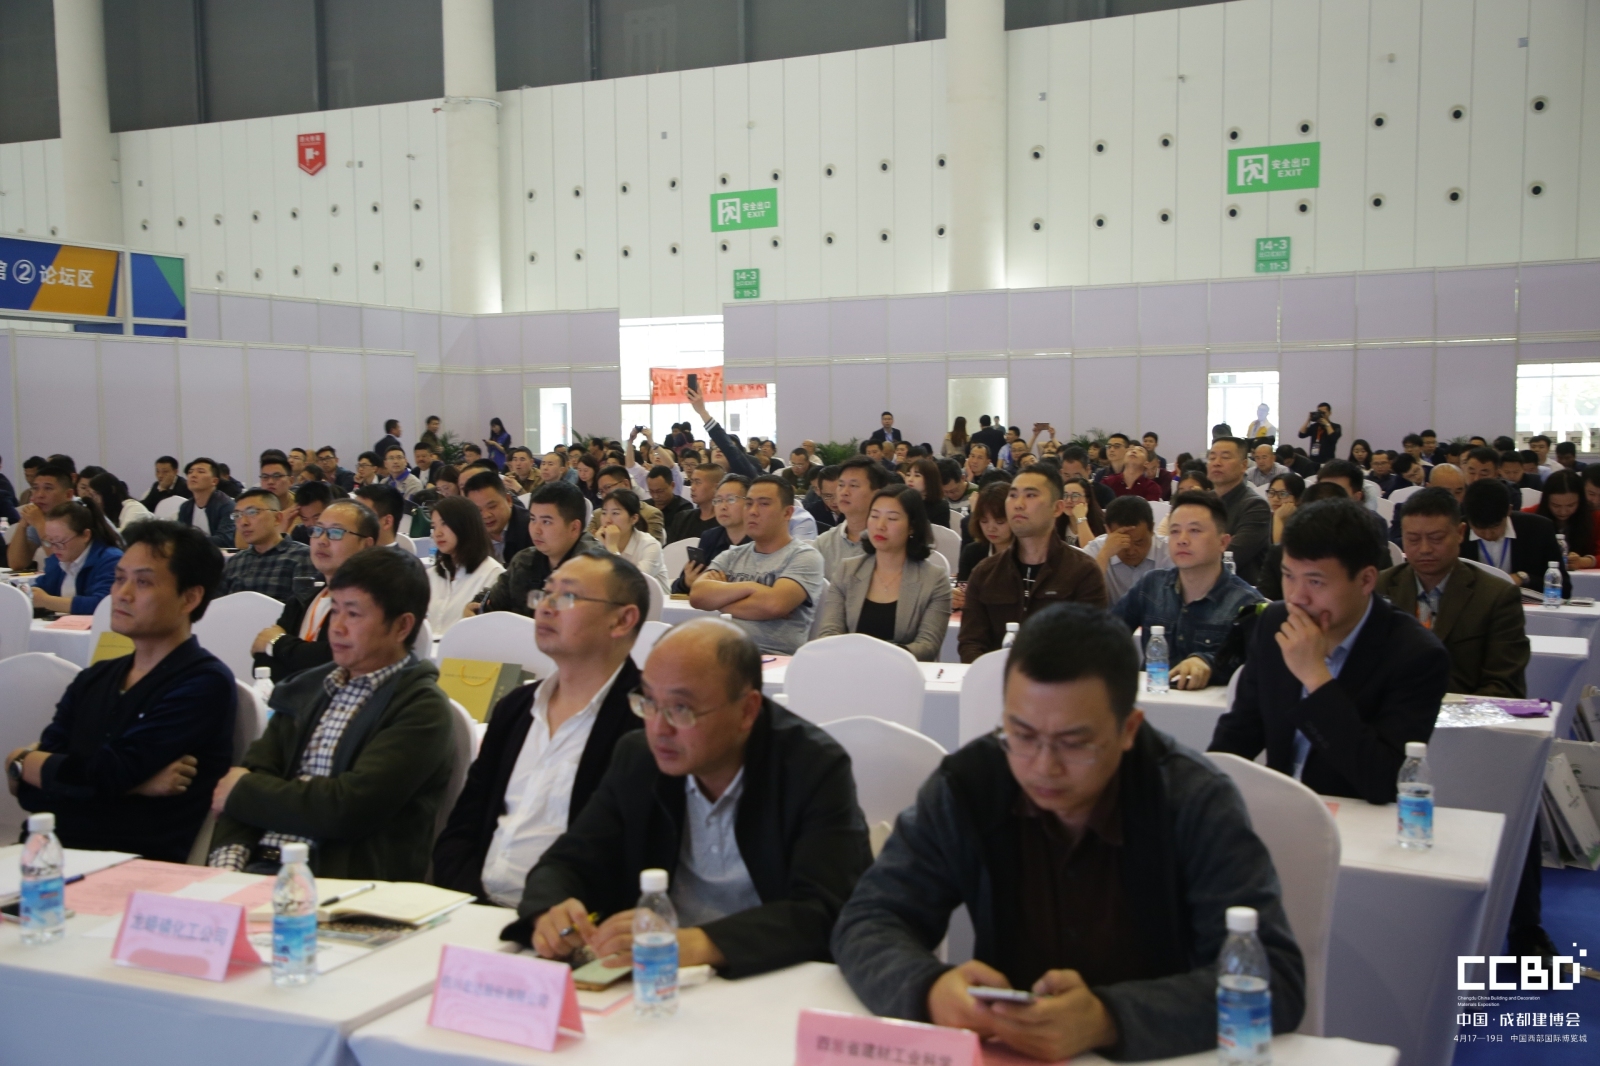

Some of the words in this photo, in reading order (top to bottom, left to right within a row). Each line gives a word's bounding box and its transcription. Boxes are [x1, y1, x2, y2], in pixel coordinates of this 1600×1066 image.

[1271, 157, 1311, 170] 安全出口
[1277, 168, 1303, 178] EXIT
[747, 210, 766, 218] EXIT
[1258, 239, 1288, 251] 14-3
[735, 271, 757, 281] 14-3
